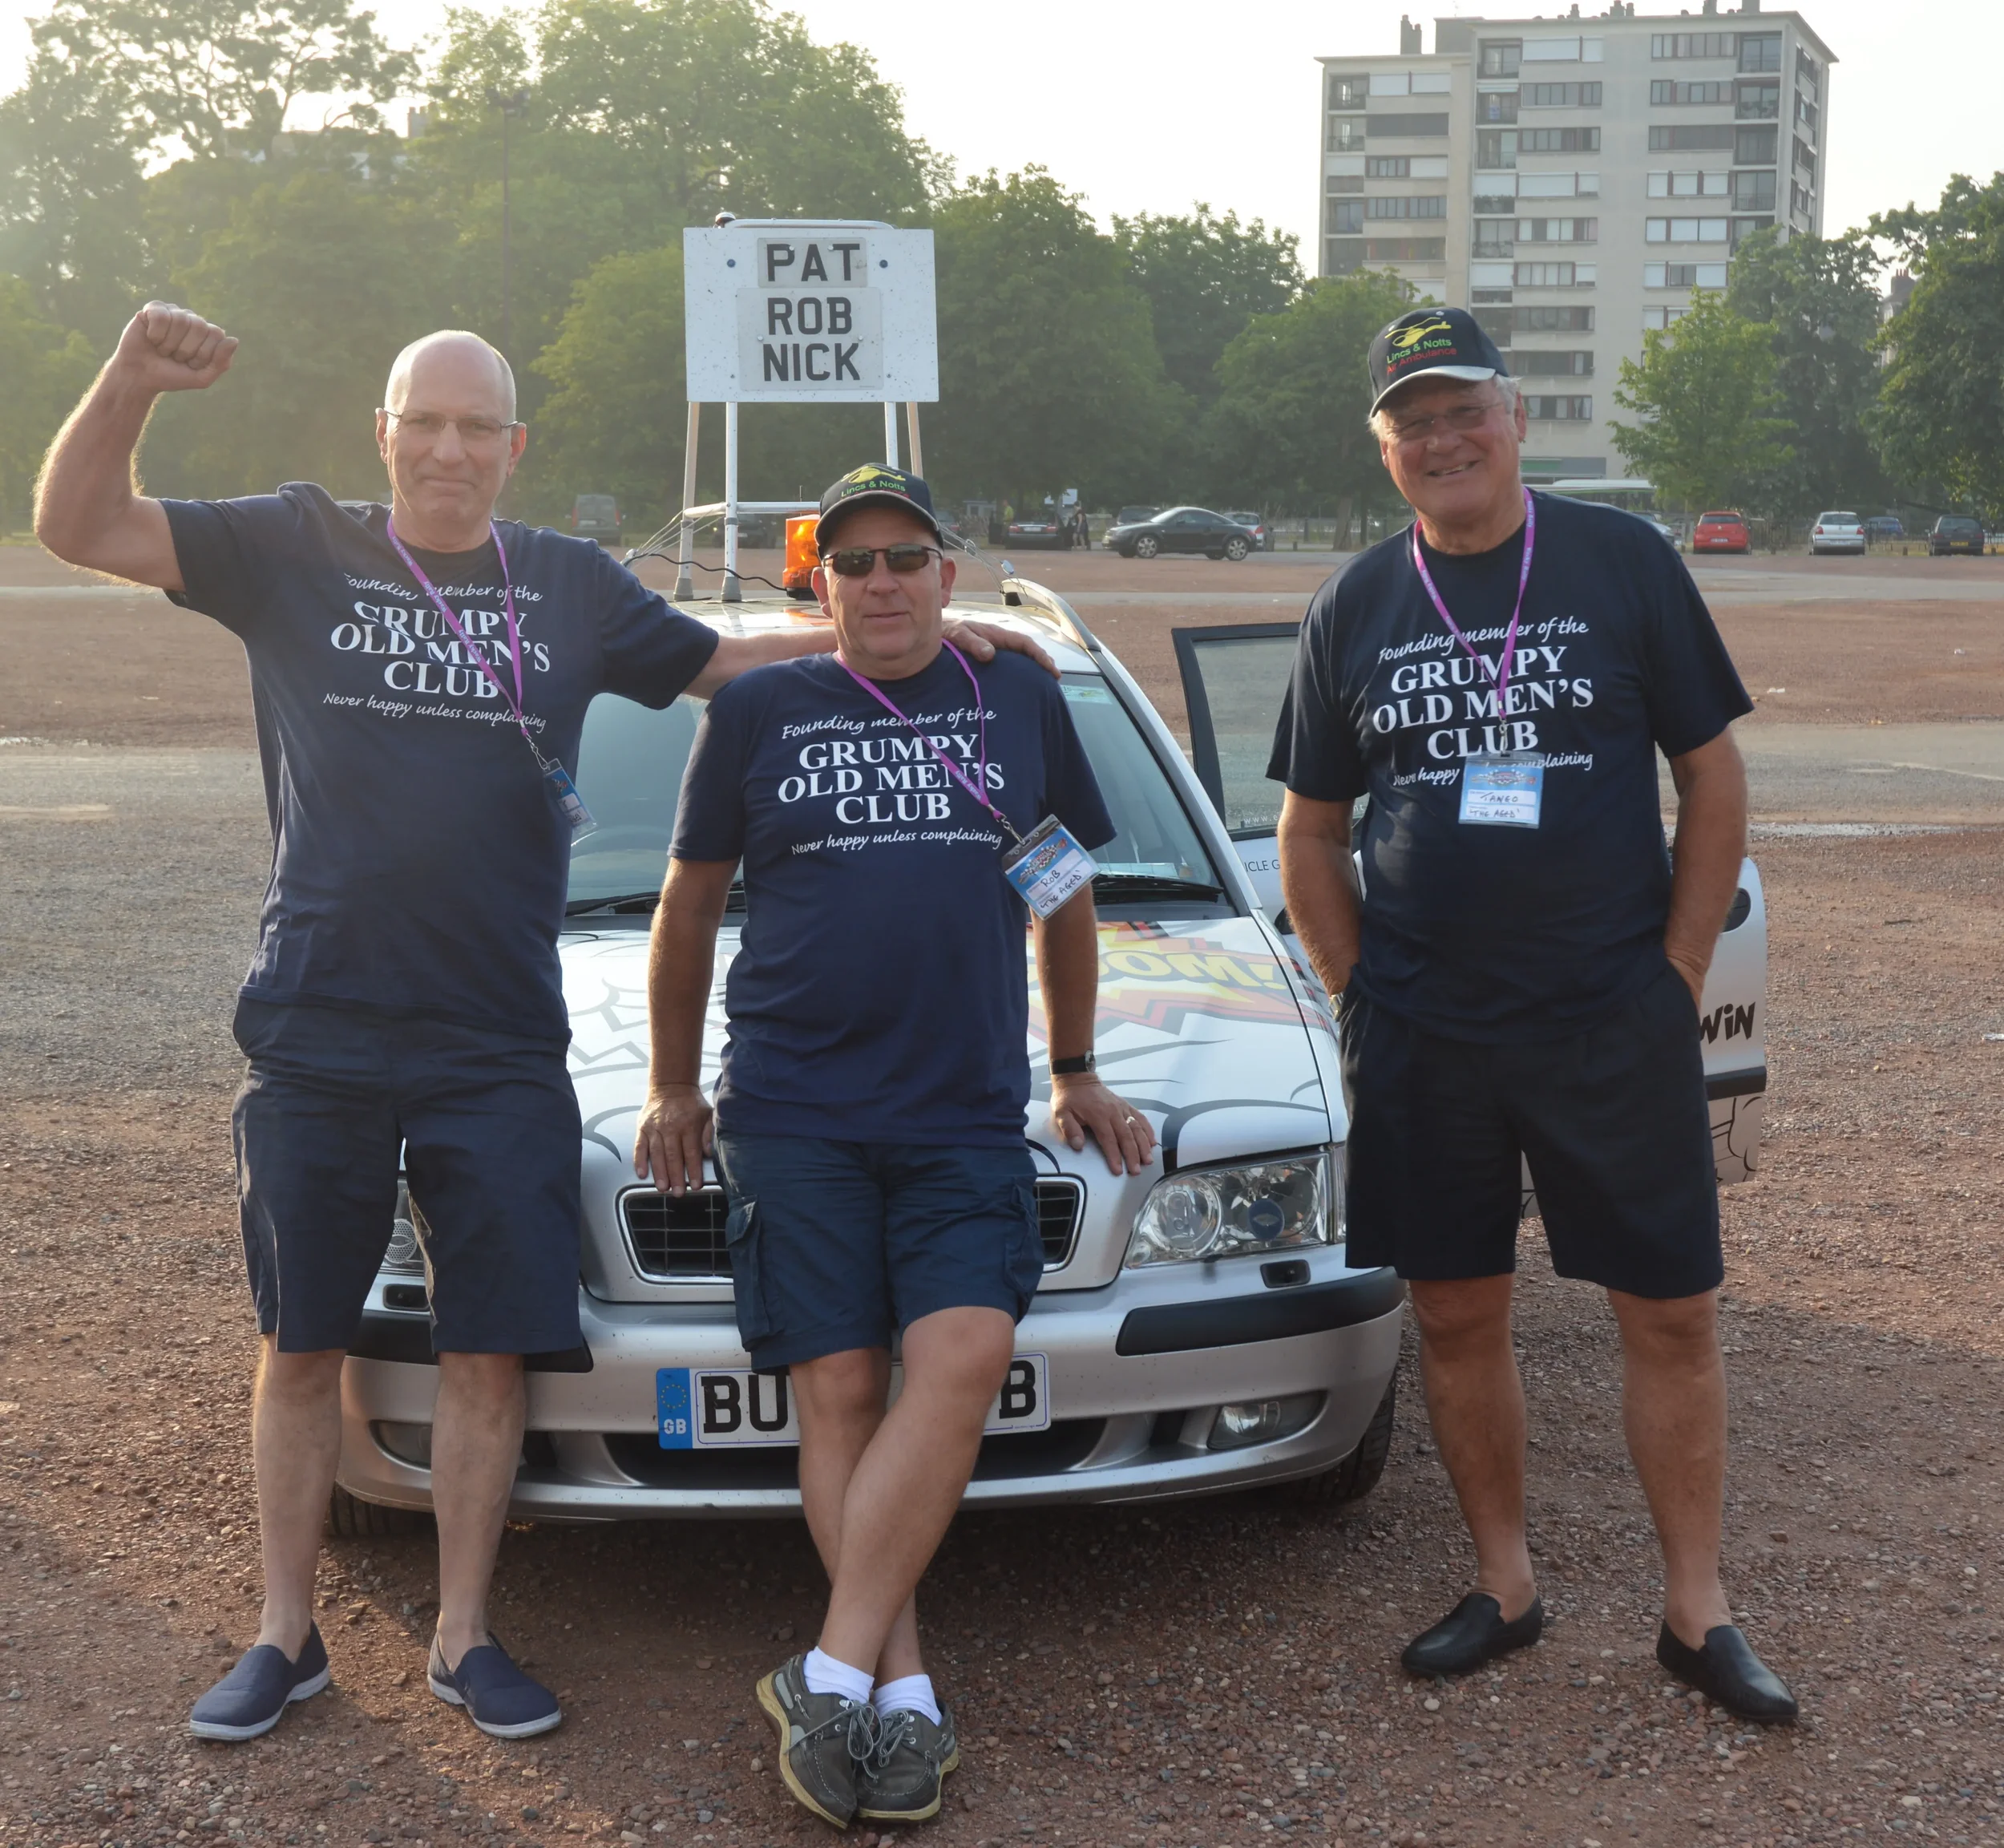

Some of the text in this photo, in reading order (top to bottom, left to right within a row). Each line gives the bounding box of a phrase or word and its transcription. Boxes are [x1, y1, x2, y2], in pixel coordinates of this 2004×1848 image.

[766, 244, 860, 281] PAT
[767, 297, 852, 335] ROB
[762, 342, 861, 382] NICK
[1386, 338, 1452, 364] Lincs & Notts
[1387, 347, 1457, 376] Air Ambulance
[841, 483, 866, 497] Lincs
[879, 480, 906, 491] Notts
[424, 581, 446, 613] Wacky Rally
[497, 584, 513, 606] of
[514, 585, 543, 601] the
[354, 601, 527, 639] GRUMPY
[1461, 620, 1534, 644] memer
[1537, 617, 1559, 642] of
[1558, 616, 1590, 634] the
[330, 623, 415, 654] OLD
[459, 629, 481, 662] Wacky Rally
[383, 660, 499, 699] CLUB
[1391, 645, 1568, 694] GRUMPY
[323, 693, 364, 706] Never
[366, 694, 413, 718] happy
[416, 702, 463, 718] unless
[1372, 678, 1594, 734] OLD MEN'S
[782, 715, 866, 739] Founding
[947, 708, 967, 729] of
[966, 707, 996, 721] the
[798, 734, 980, 770] GRUMPY
[1427, 721, 1539, 759] CLUB
[778, 769, 863, 803] OLD
[875, 762, 1005, 791] MEN'S
[967, 783, 982, 800] Wacky
[1417, 766, 1461, 786] happy
[835, 793, 951, 824] CLUB
[791, 827, 1003, 855] Never happy unless complaining
[664, 1418, 686, 1435] GB
